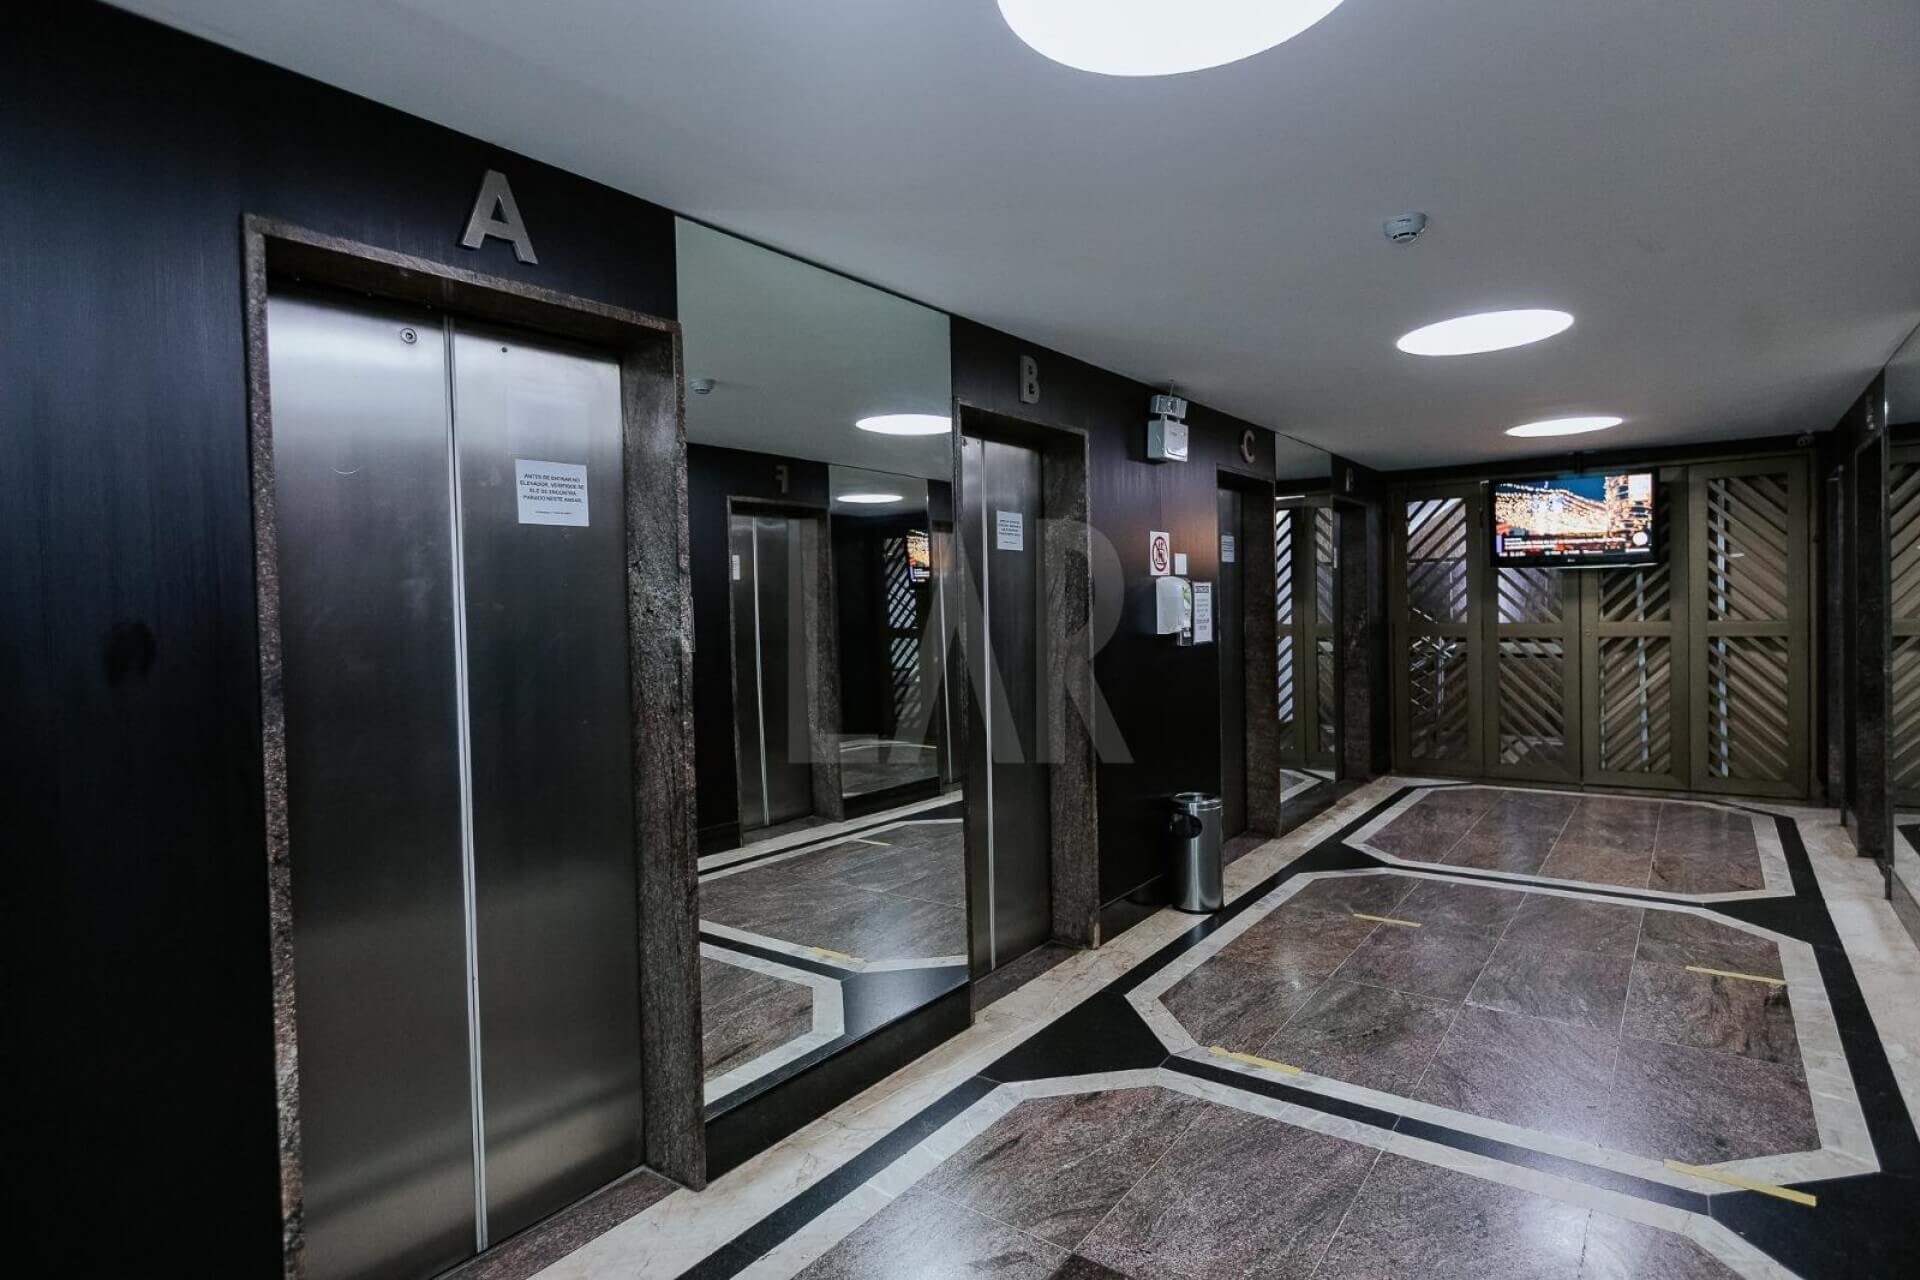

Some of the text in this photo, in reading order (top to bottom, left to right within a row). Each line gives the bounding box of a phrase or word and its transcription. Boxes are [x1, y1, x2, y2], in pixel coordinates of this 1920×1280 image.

[462, 169, 538, 265] A
[1020, 355, 1040, 404] B
[1240, 430, 1256, 463] C
